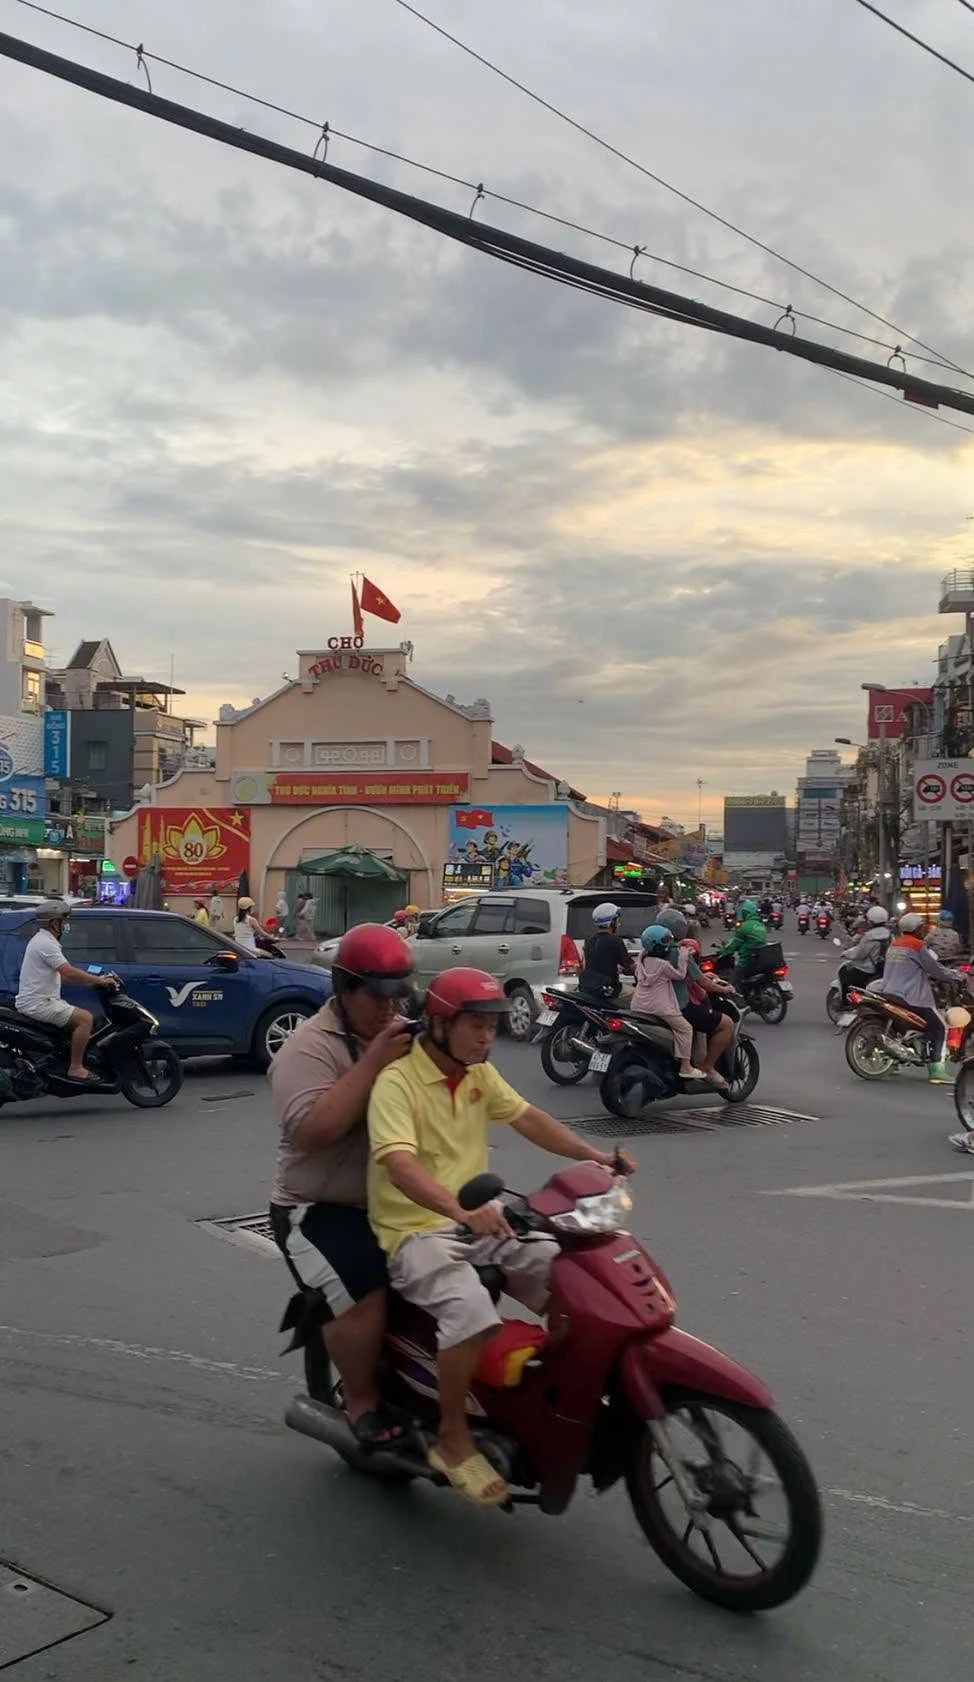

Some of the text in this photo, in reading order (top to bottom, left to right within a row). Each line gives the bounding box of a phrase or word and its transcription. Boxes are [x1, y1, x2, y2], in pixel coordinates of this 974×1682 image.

[327, 637, 364, 652] CHỢ
[308, 651, 383, 679] THỦ ĐỨC
[10, 788, 37, 812] 315
[184, 842, 204, 858] 80
